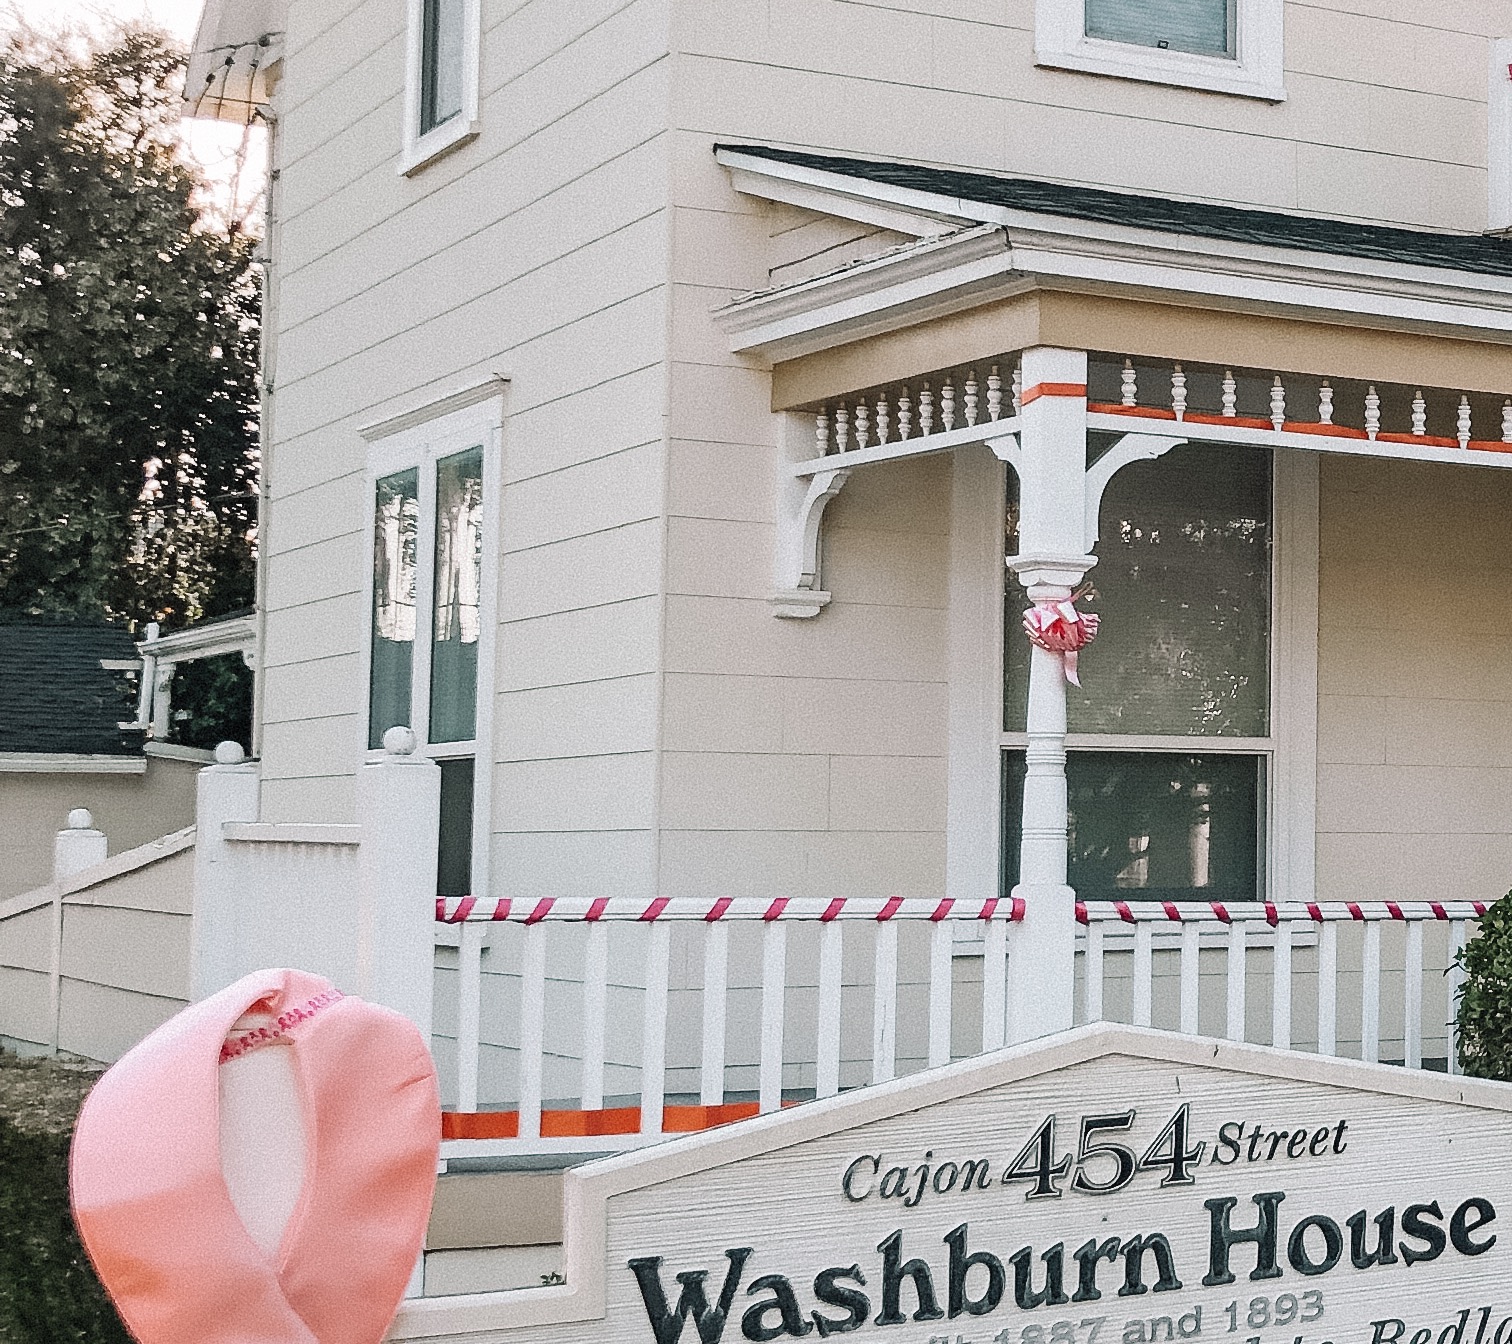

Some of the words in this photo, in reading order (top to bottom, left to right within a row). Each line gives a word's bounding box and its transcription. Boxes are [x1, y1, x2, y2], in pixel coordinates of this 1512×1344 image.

[842, 1150, 993, 1208] Cajon
[1001, 1101, 1206, 1201] 454
[1209, 1118, 1350, 1167] Street
[1200, 1189, 1498, 1288] House
[1223, 1288, 1326, 1335] 1893
